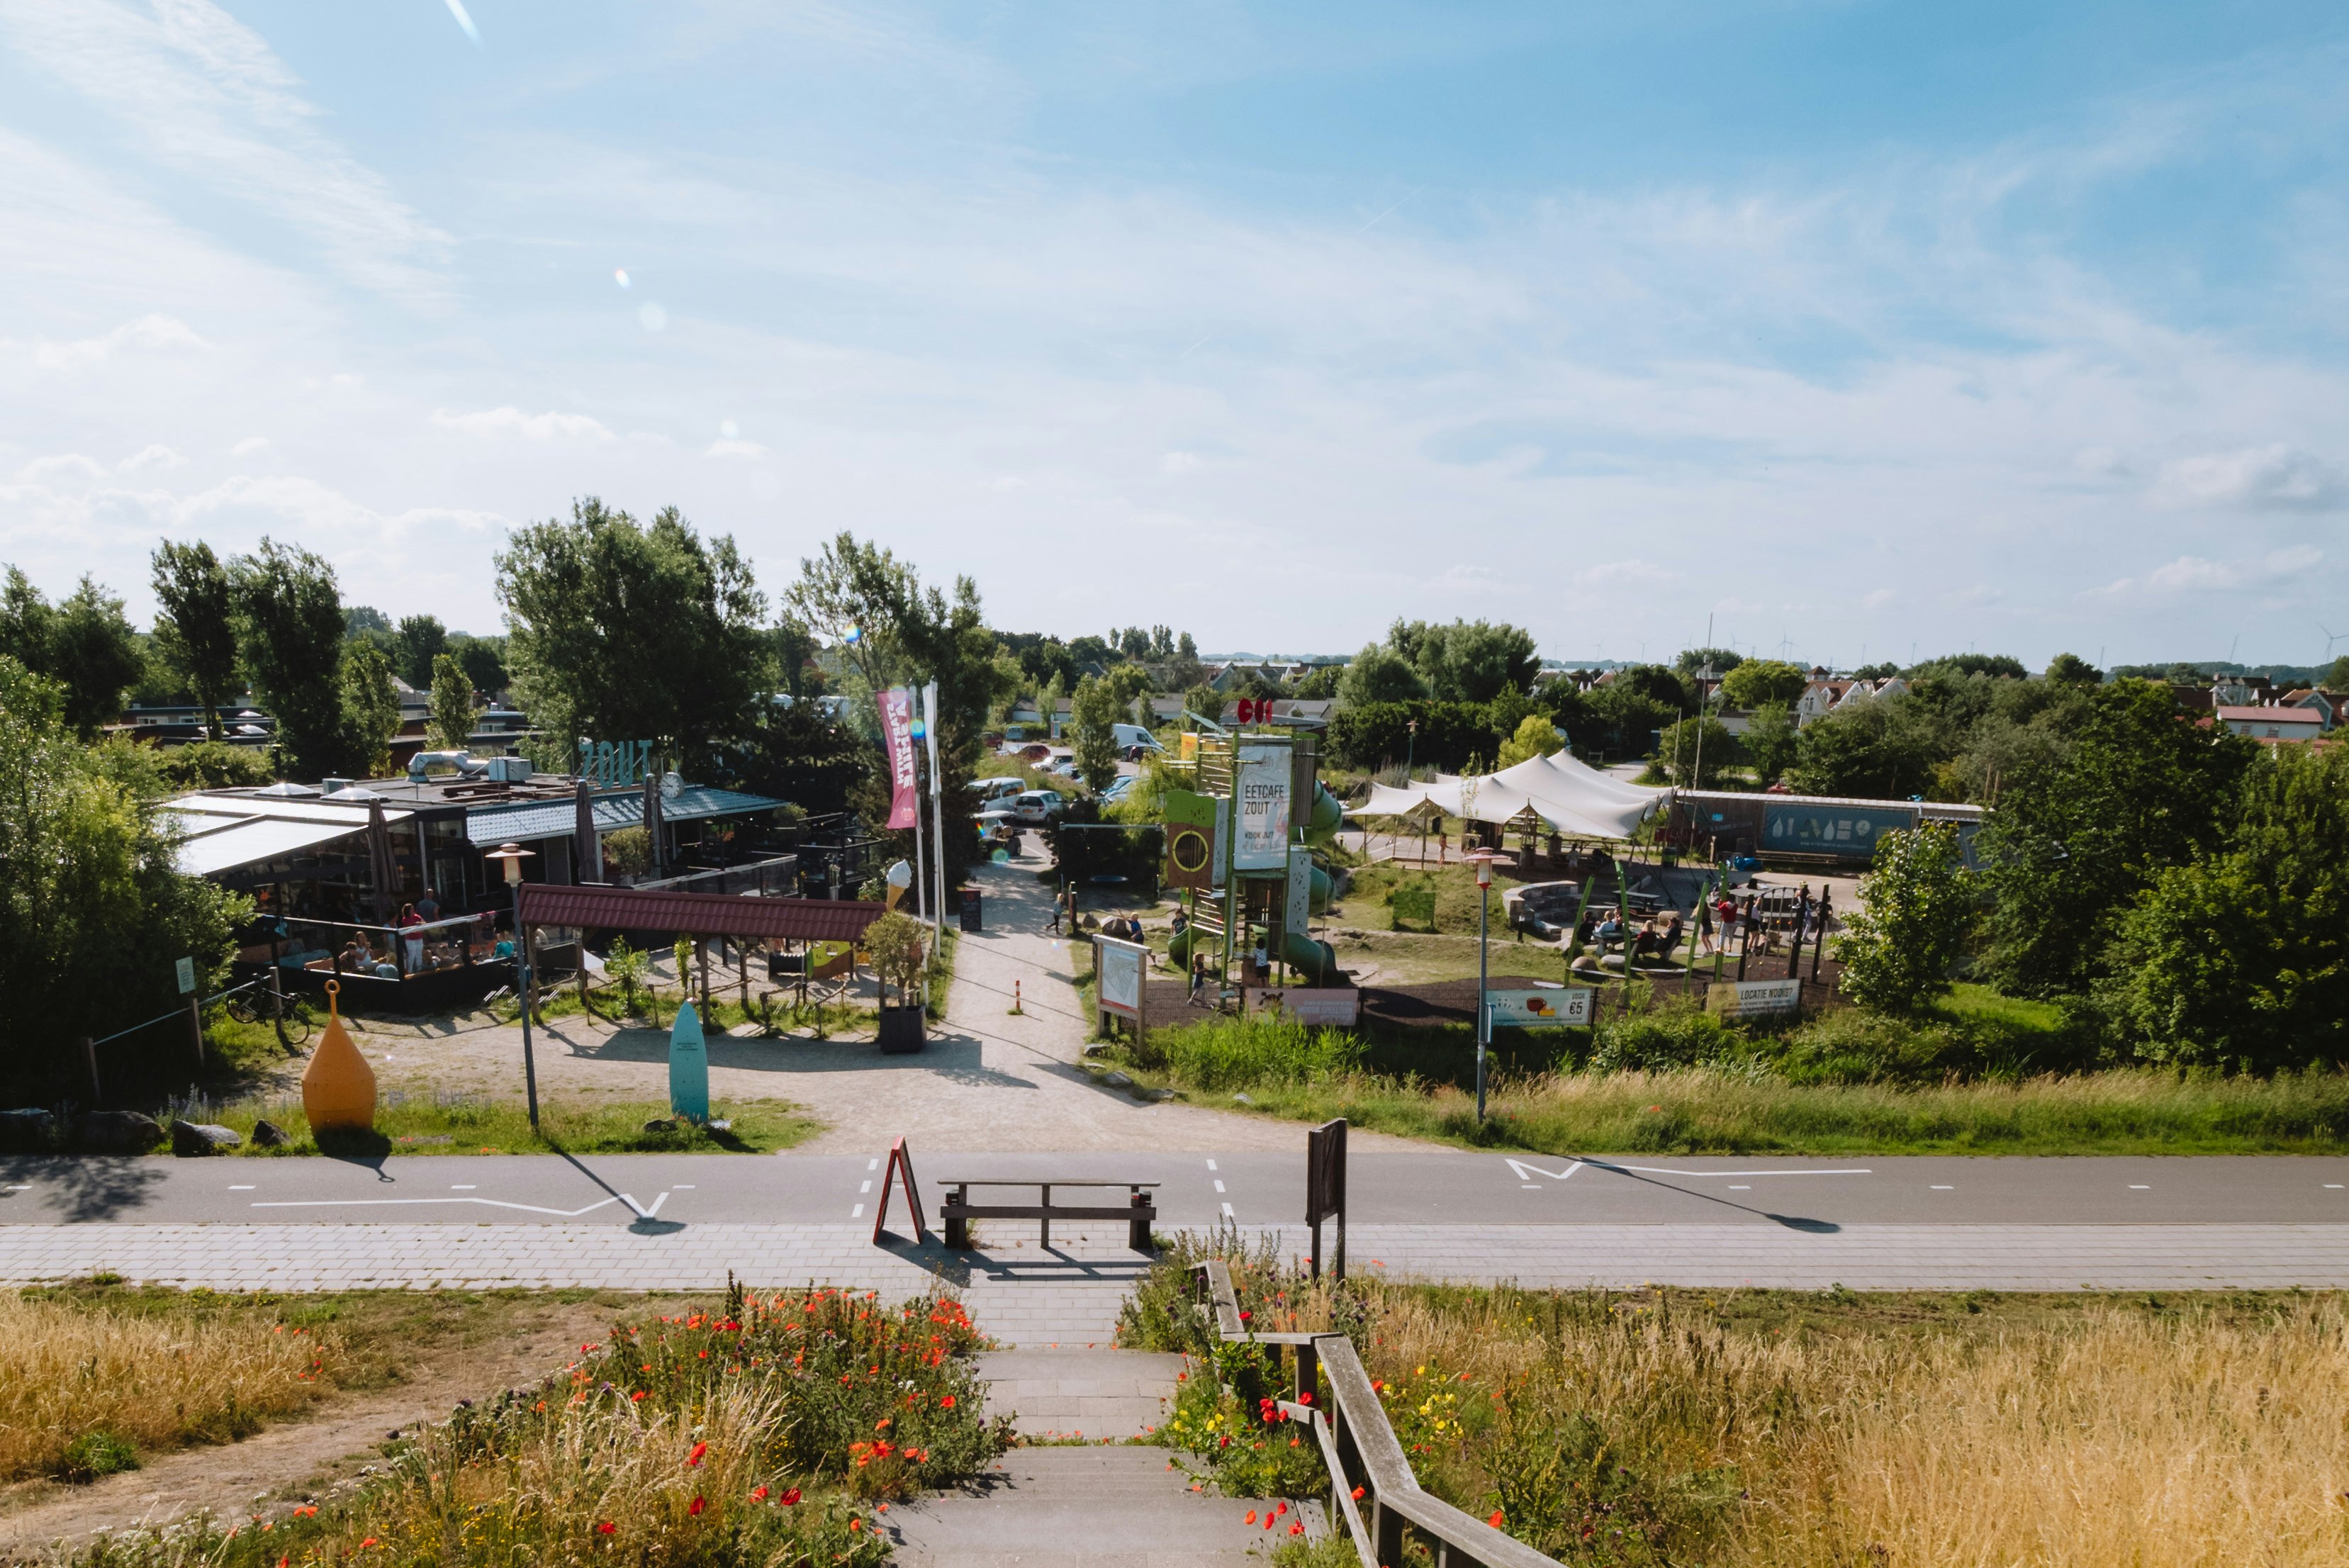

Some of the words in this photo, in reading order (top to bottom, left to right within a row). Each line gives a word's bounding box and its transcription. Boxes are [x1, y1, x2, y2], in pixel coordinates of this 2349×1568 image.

[578, 739, 653, 792] ZOUT
[1245, 785, 1284, 798] EETCAFE
[1245, 801, 1269, 814] ZOUT
[1740, 989, 1766, 1000] LOCATIE
[1768, 987, 1793, 998] NODIG?
[1569, 1002, 1583, 1014] €5
